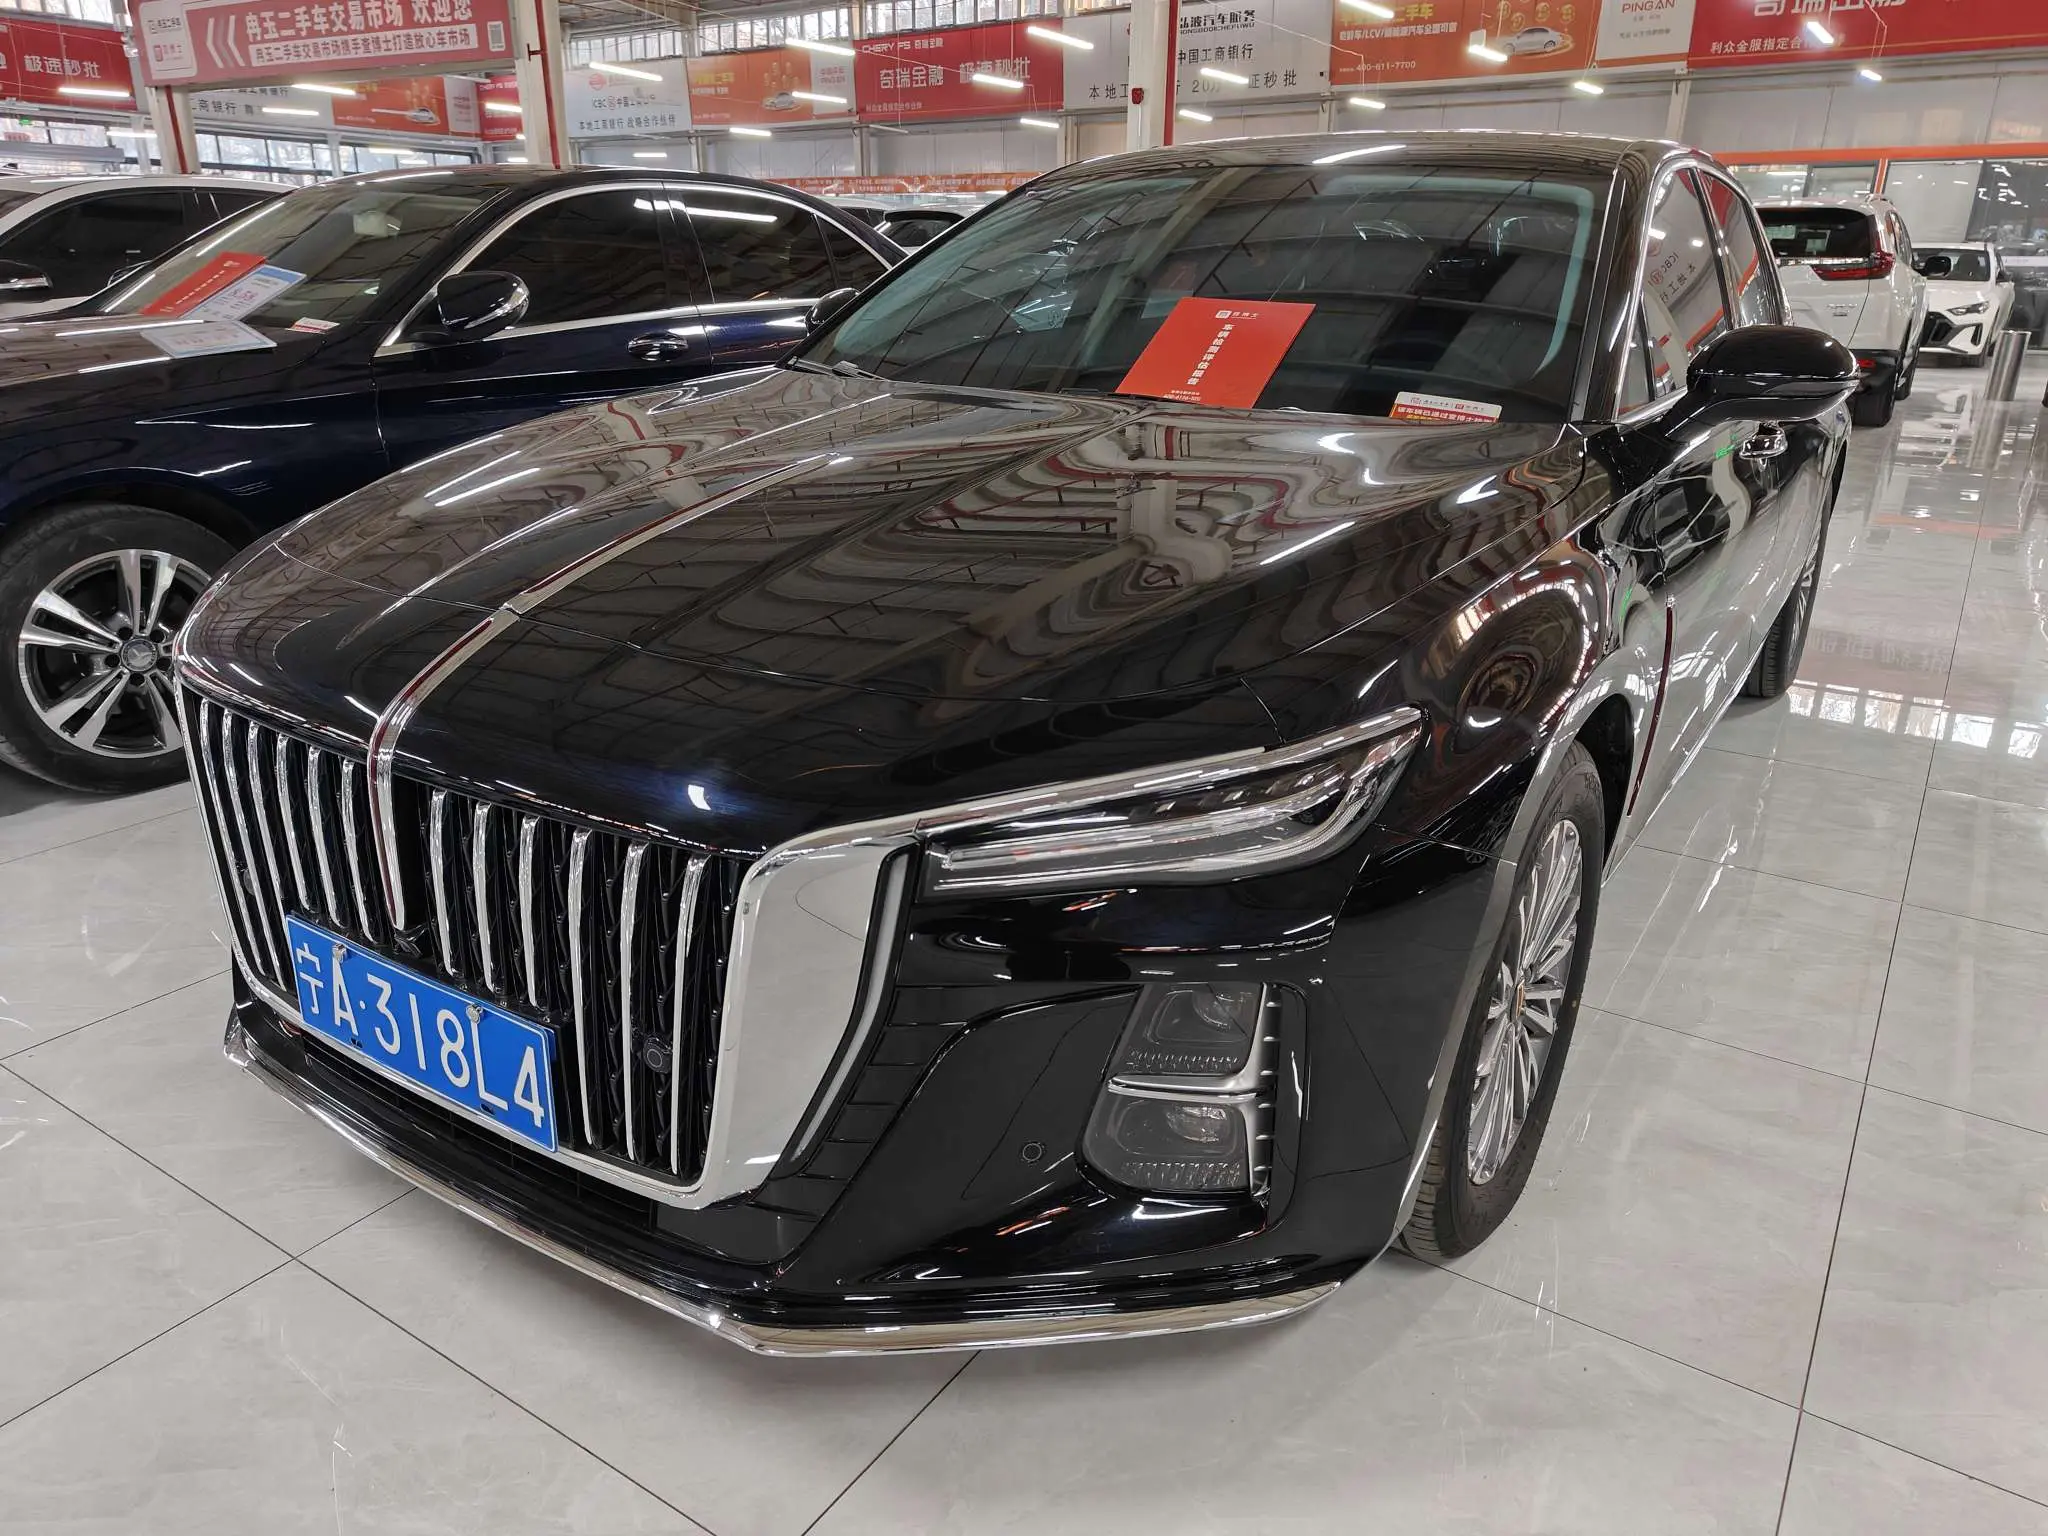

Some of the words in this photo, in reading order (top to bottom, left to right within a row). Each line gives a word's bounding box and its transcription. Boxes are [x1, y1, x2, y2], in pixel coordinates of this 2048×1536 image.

[1621, 0, 1676, 13] PINGAN
[24, 53, 102, 79] 极速秒批
[1178, 43, 1253, 66] 中国工商银行
[879, 65, 944, 89] 奇瑞金融
